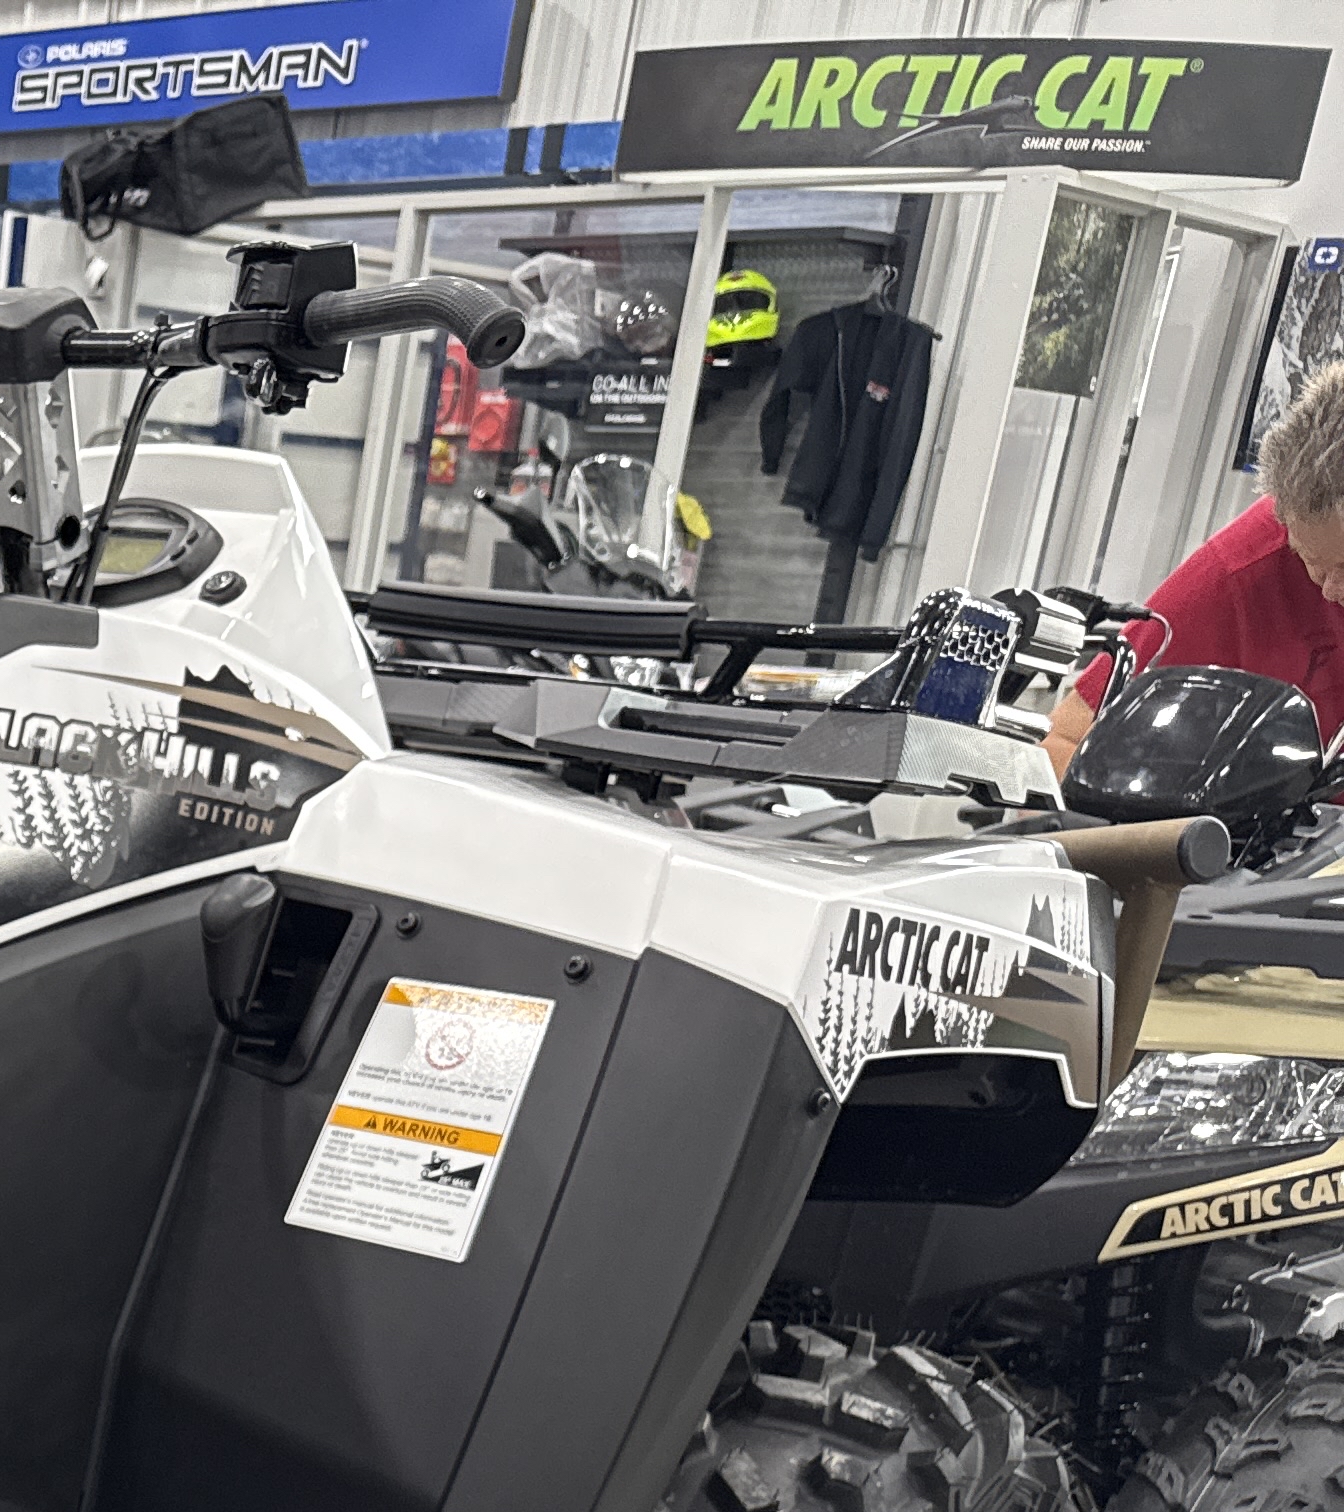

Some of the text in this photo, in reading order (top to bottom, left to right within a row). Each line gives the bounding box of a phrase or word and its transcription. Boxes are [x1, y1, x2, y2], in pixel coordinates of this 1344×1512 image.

[46, 38, 128, 63] POLARIS
[12, 38, 359, 112] SPORTSMAN
[736, 54, 1028, 131] ARCTIC
[1021, 136, 1063, 151] SHARE
[1064, 137, 1089, 151] OUR
[178, 799, 277, 836] EDITION
[833, 907, 991, 994] ARCTIC CAT
[381, 1115, 461, 1145] WARNING
[1160, 1184, 1282, 1240] ARCTIC
